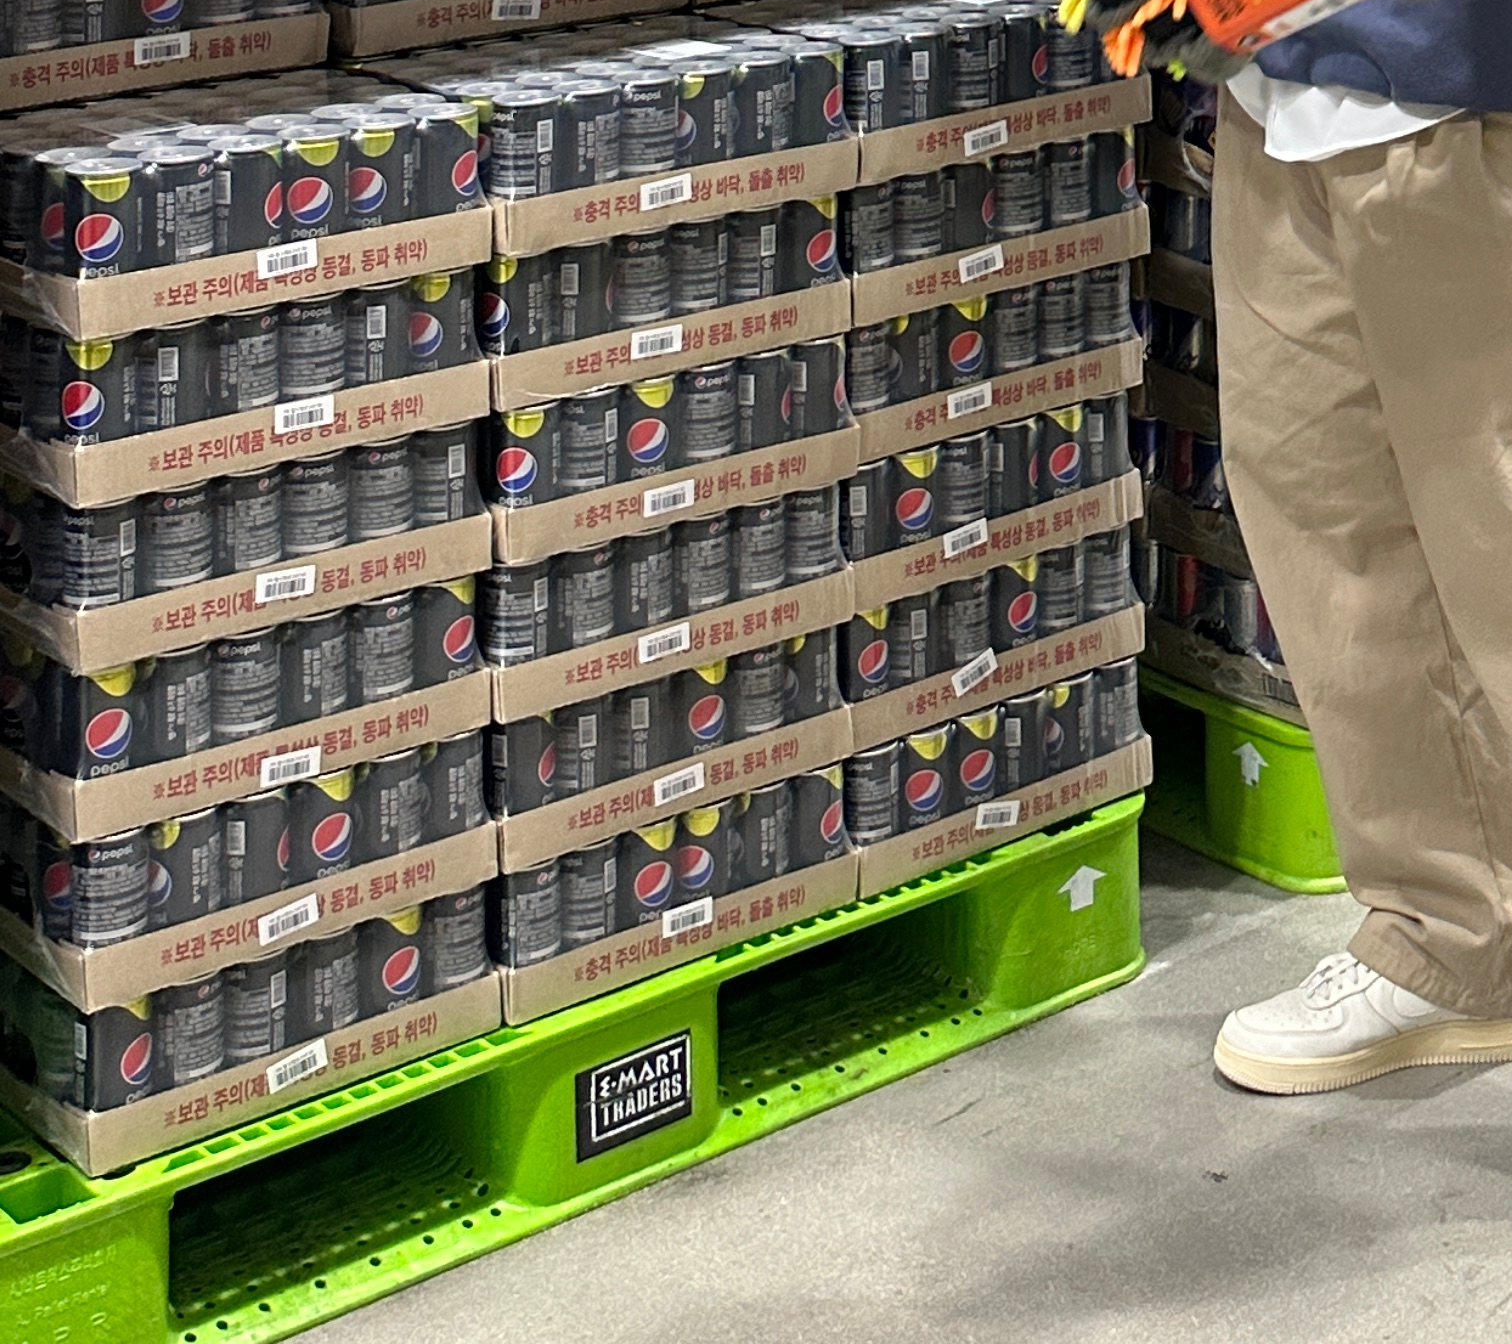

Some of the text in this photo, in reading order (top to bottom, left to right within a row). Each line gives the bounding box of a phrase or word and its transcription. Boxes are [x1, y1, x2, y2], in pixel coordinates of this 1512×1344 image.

[716, 174, 745, 198] 바닥,
[748, 168, 773, 194] 돌출
[777, 161, 806, 188] 취약)
[322, 252, 356, 278] 동결,
[360, 245, 391, 270] 동파
[393, 238, 429, 264] 취약)
[357, 401, 387, 427] 동파
[390, 393, 424, 420] 취약)
[230, 641, 261, 658] pepsi
[89, 757, 130, 777] pepsi
[332, 1039, 367, 1070] 동결,
[370, 1025, 402, 1057] 동파
[404, 1011, 438, 1041] 취약)
[600, 1072, 682, 1127] TRADERS
